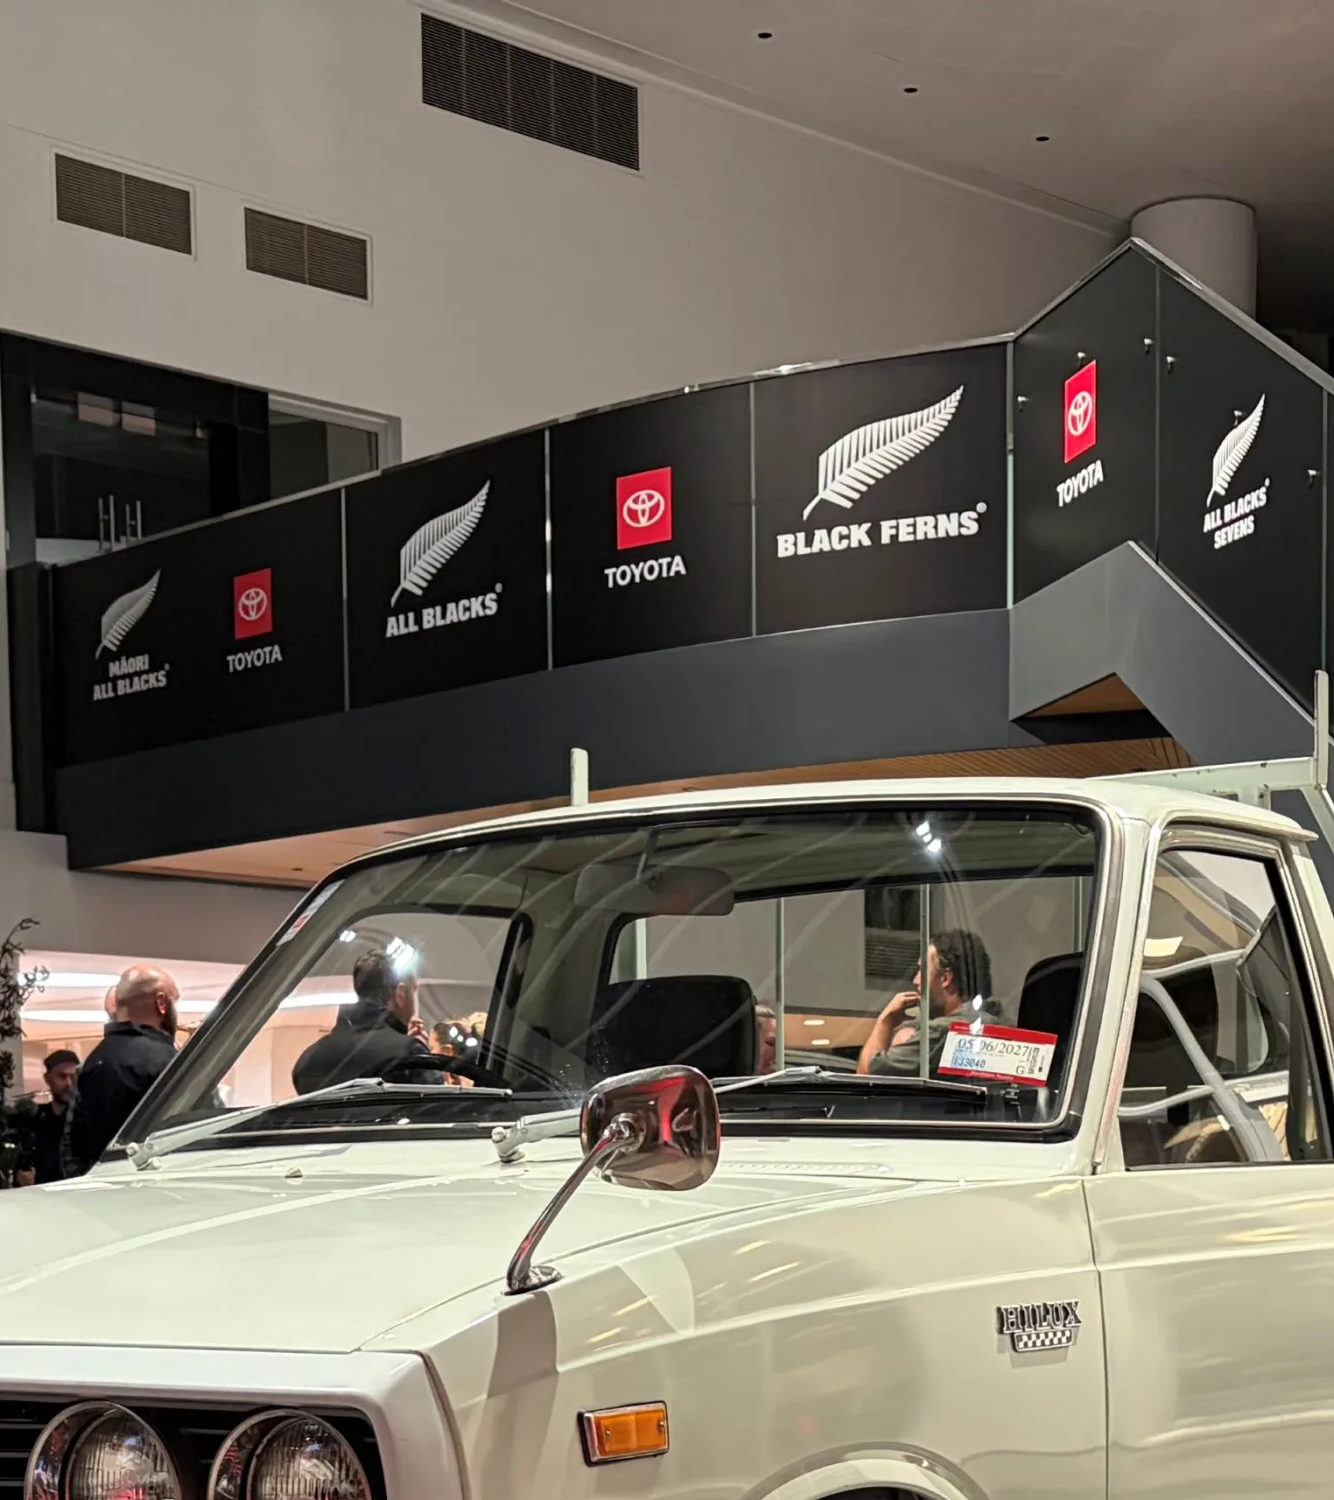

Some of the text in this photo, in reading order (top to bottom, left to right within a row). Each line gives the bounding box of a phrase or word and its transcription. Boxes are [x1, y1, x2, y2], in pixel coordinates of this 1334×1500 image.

[1056, 459, 1104, 508] TOYOTA
[1203, 486, 1267, 533] ALL BLACKS
[776, 522, 873, 559] BLACK
[1214, 514, 1255, 550] SEVENS
[604, 555, 687, 588] TOYOTA
[385, 592, 499, 638] ALL BLACKS
[226, 645, 282, 672] TOYOTA
[93, 669, 168, 701] ALL BLACKS
[957, 1037, 1030, 1056] 0506/2027
[1000, 1299, 1083, 1333] HILUX
